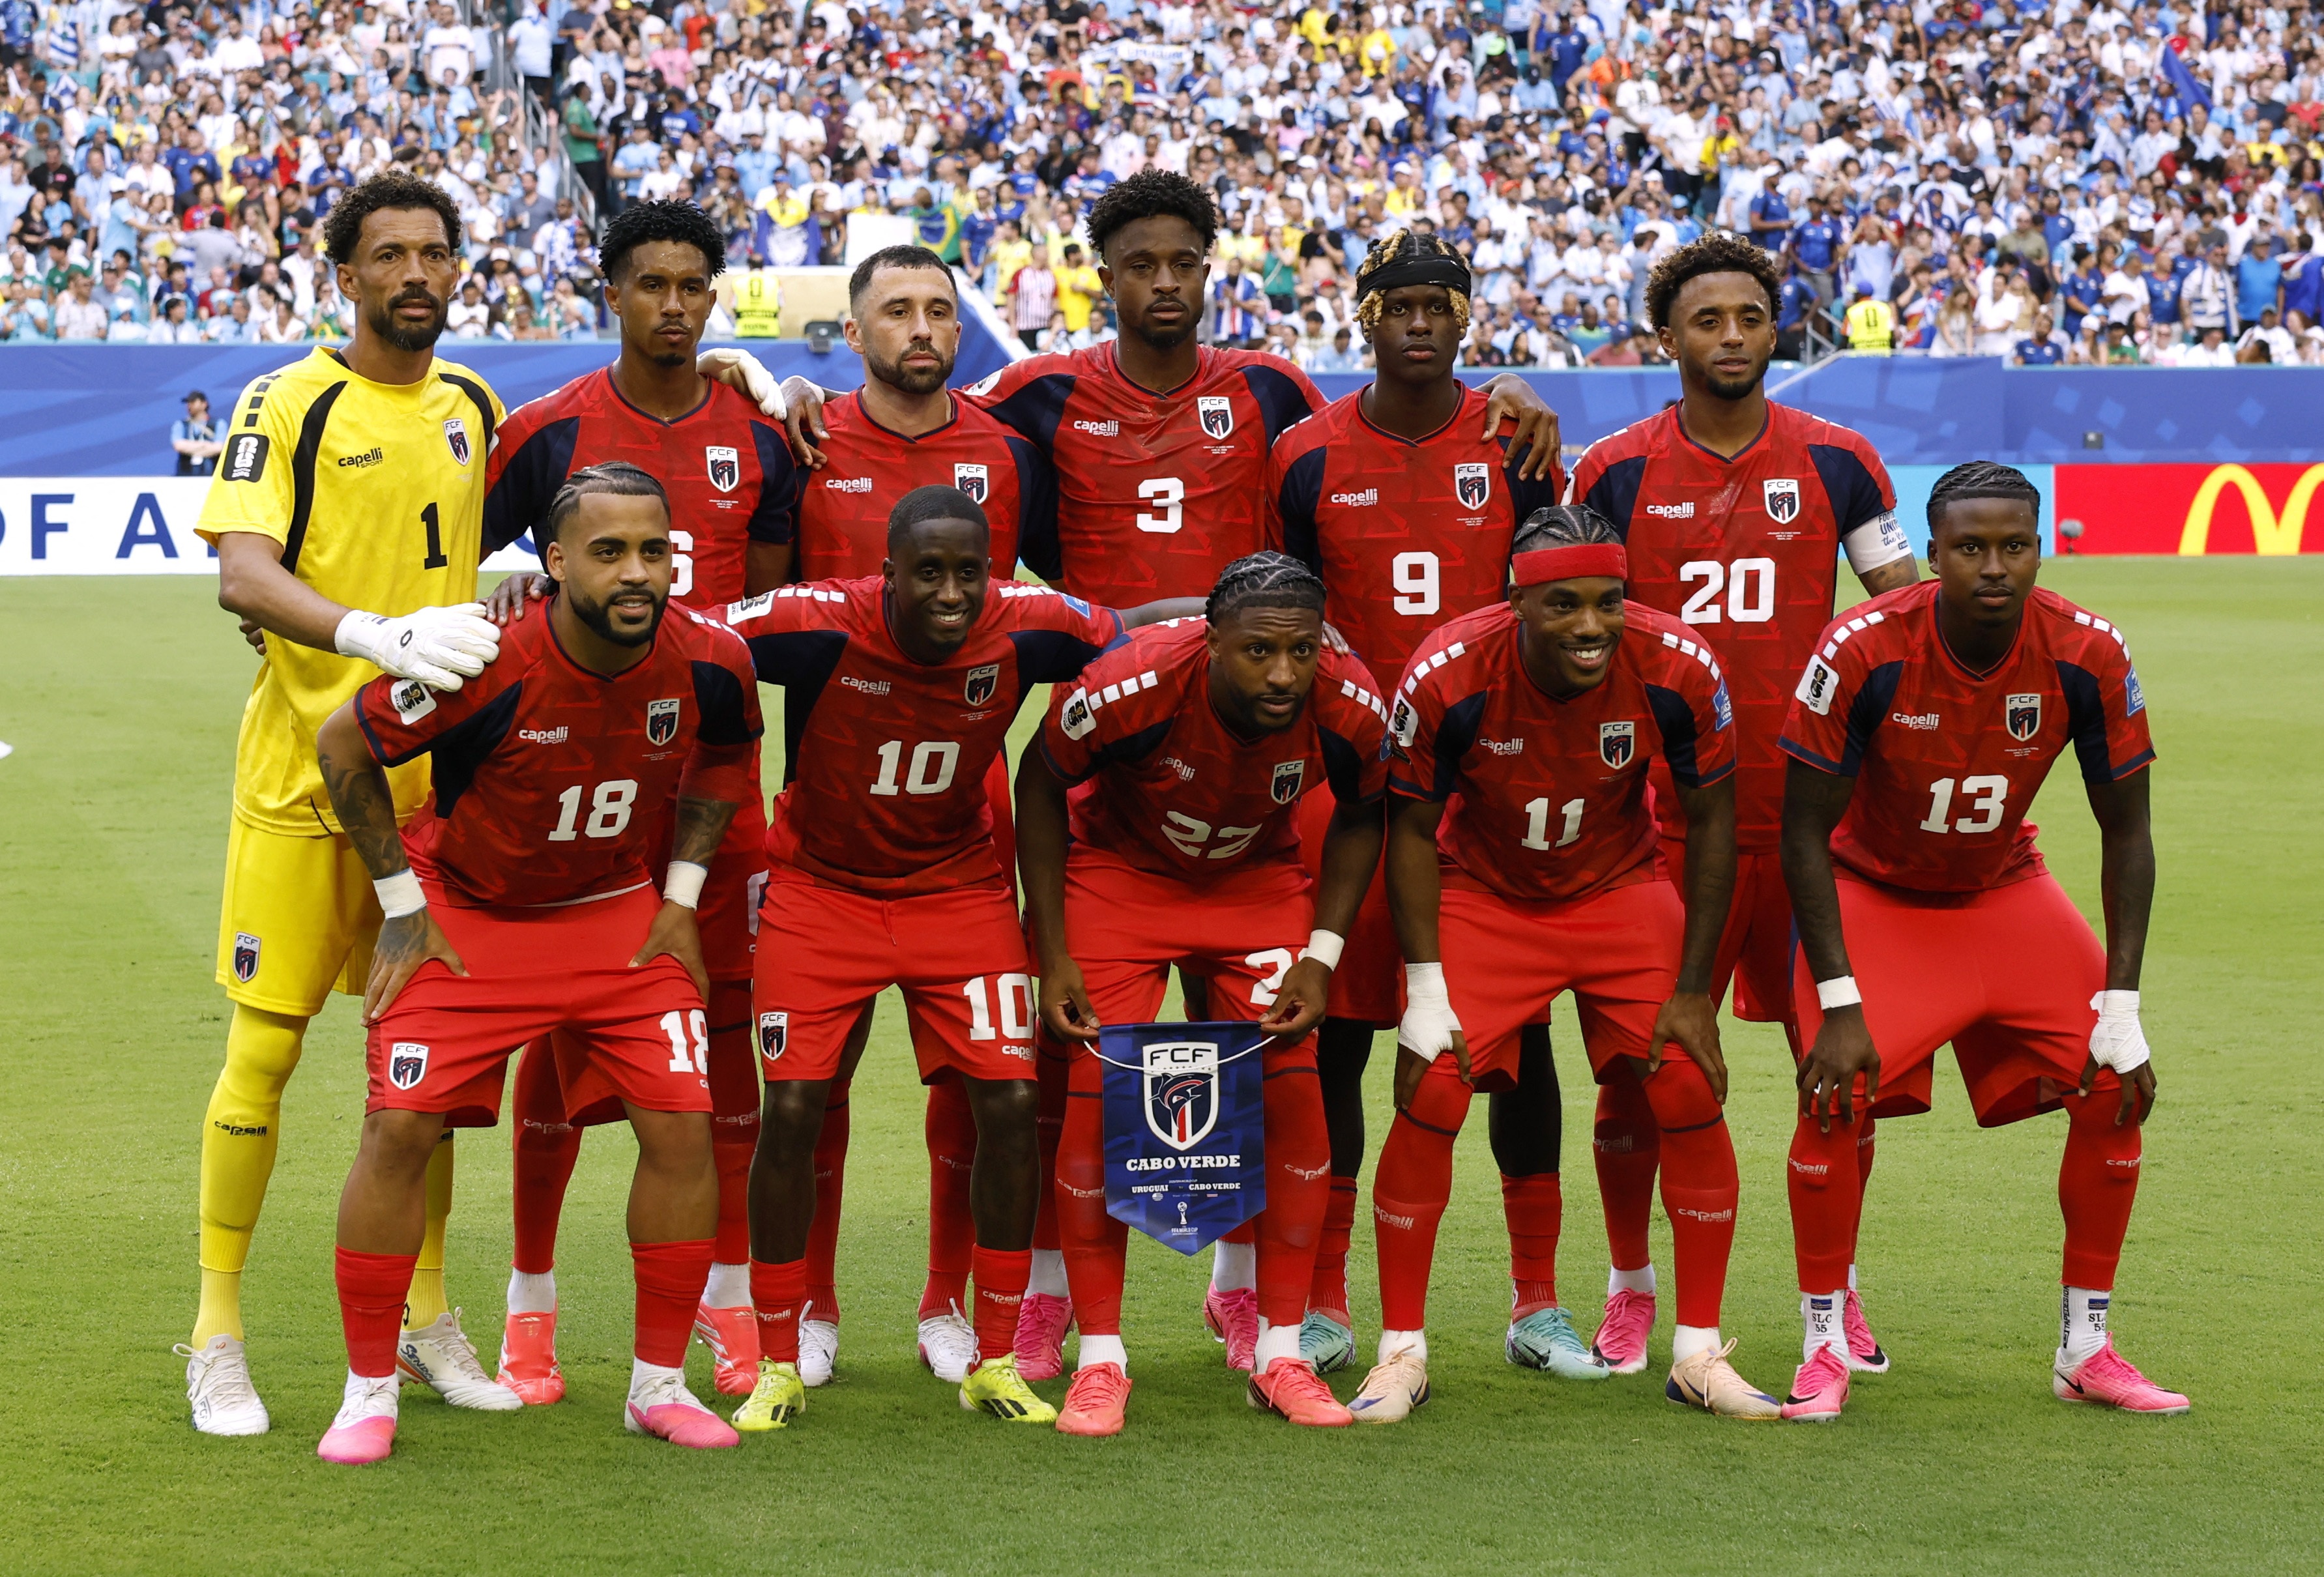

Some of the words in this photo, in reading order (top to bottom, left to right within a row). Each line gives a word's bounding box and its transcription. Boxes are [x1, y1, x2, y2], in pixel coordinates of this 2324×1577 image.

[445, 420, 461, 431] FCF
[1073, 420, 1119, 433] capelli
[338, 448, 383, 467] capelli
[360, 459, 383, 469] SPORT
[1457, 465, 1485, 474] FCF
[826, 478, 872, 491] capelli
[1766, 481, 1796, 490] FCF
[1331, 488, 1378, 505] capelli
[1136, 477, 1185, 533] 3
[1646, 502, 1694, 517] capelli
[0, 493, 74, 559] F
[420, 501, 448, 570] 1
[1392, 551, 1440, 616] 9
[1679, 557, 1776, 624] 20
[970, 666, 998, 677] FCF
[841, 676, 891, 693] capelli
[650, 701, 678, 711] FCF
[2009, 696, 2039, 704] FCF
[1892, 712, 1940, 728] capelli
[519, 726, 569, 743] capelli
[1603, 723, 1632, 733] FCF
[1479, 738, 1524, 754] capelli
[869, 740, 961, 796] 10
[1276, 762, 1302, 773] FCF
[547, 779, 639, 841] 18
[1919, 775, 2009, 834] 13
[1521, 797, 1585, 851] 11
[237, 934, 258, 946] FCF
[1244, 948, 1307, 1006] 2
[963, 973, 1035, 1041] 10
[762, 1014, 785, 1022] FCF
[1150, 1047, 1212, 1066] FCF
[214, 1121, 267, 1135] capelli
[1126, 1157, 1176, 1172] CABO
[1178, 1154, 1241, 1168] VERDE
[1131, 1184, 1169, 1193] URUGUAI
[1678, 1208, 1732, 1221] capelli
[983, 1290, 1022, 1303] capelli
[1812, 1313, 1832, 1324] SLC
[1816, 1324, 1827, 1333] 55
